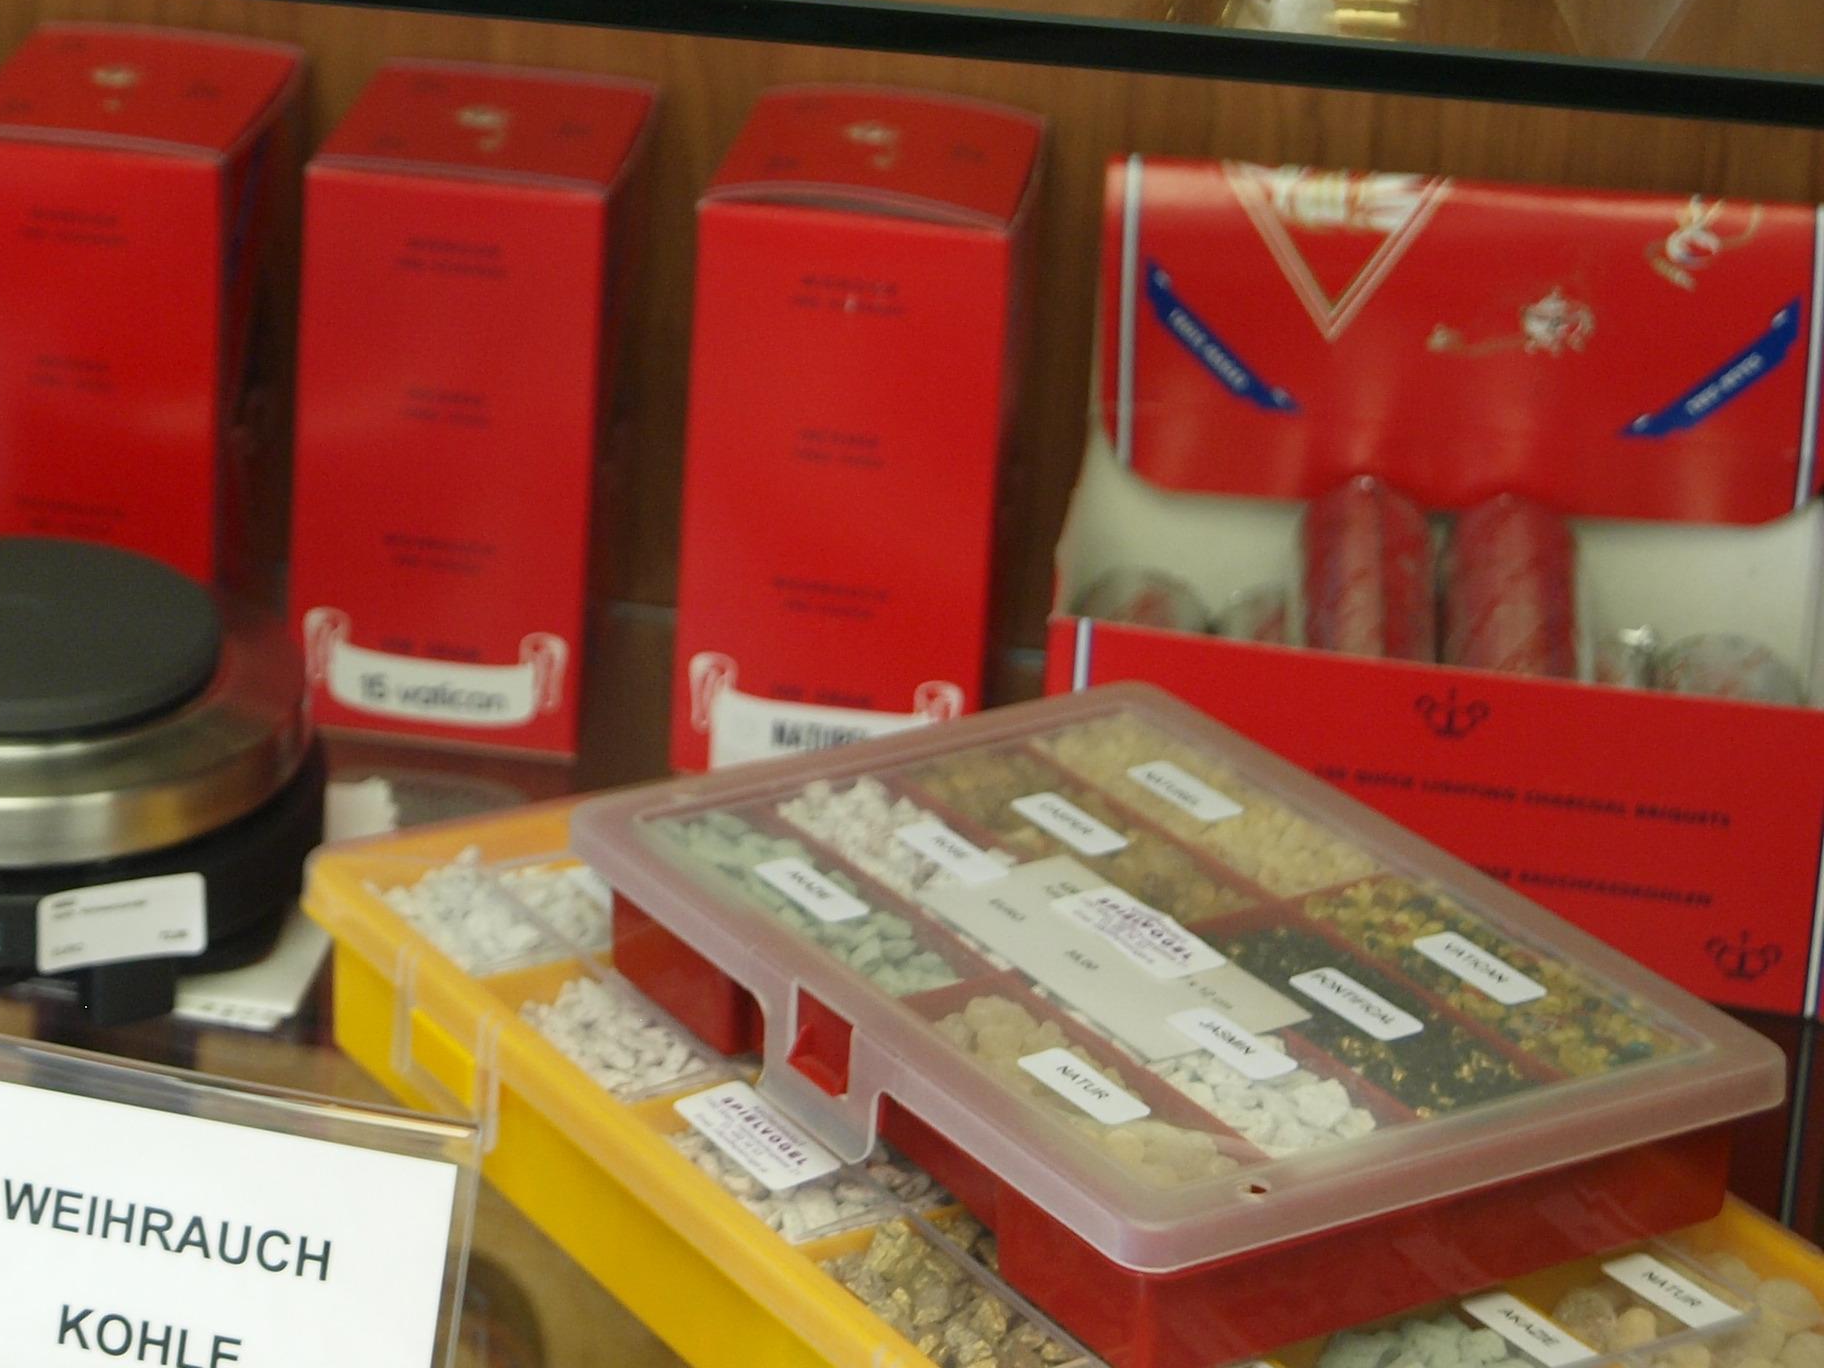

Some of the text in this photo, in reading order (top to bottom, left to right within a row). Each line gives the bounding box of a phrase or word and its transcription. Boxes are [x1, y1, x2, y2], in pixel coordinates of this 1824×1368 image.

[1056, 1065, 1111, 1100] NATUR
[720, 1096, 809, 1165] SPIELVOGEL
[3, 1178, 332, 1281] WEIHRAUCH
[1642, 1270, 1703, 1308] NATUR
